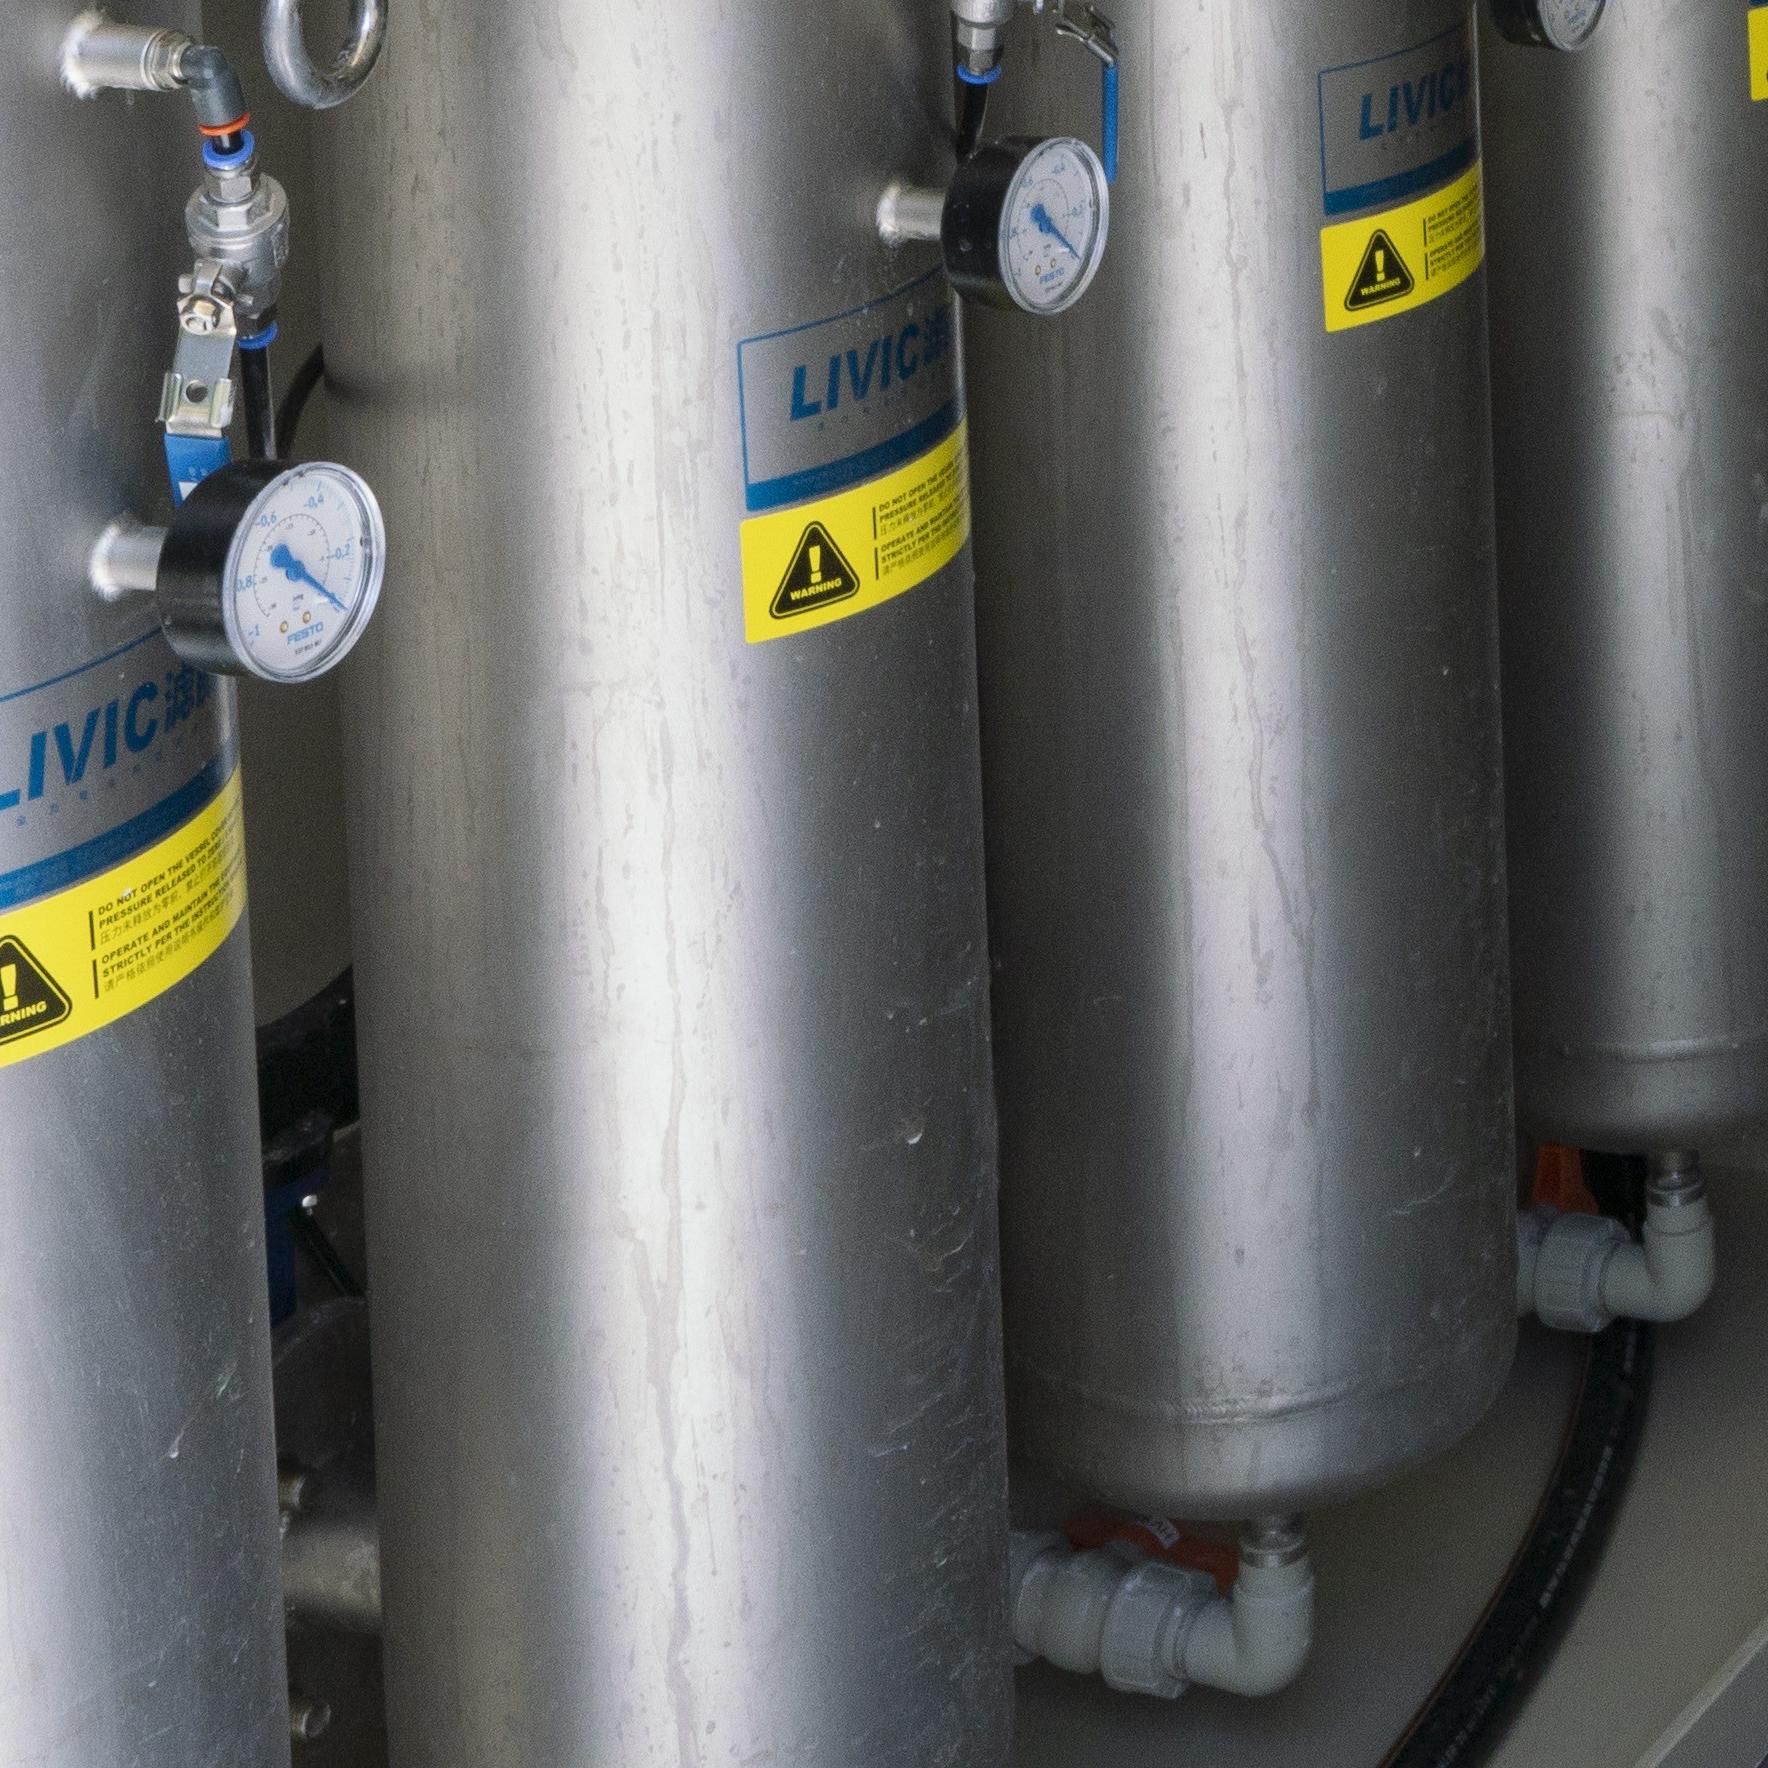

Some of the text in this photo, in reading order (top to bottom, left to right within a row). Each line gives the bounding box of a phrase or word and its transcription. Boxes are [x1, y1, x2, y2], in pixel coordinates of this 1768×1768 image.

[1360, 64, 1457, 141] LIVIC
[789, 322, 920, 421] LIVIC
[790, 577, 842, 601] WARNING
[288, 621, 324, 645] FESTO
[98, 901, 113, 916] DO
[116, 889, 137, 906] NOT
[140, 873, 166, 894] OPEN
[167, 858, 184, 876] THE
[99, 895, 153, 929] PRESSURE
[155, 864, 197, 898] RELEASED
[101, 931, 150, 964] OPERATE
[152, 919, 171, 939] AND
[103, 946, 152, 978] STRICTLY
[155, 932, 172, 949] PER
[0, 1000, 47, 1026] RNING
